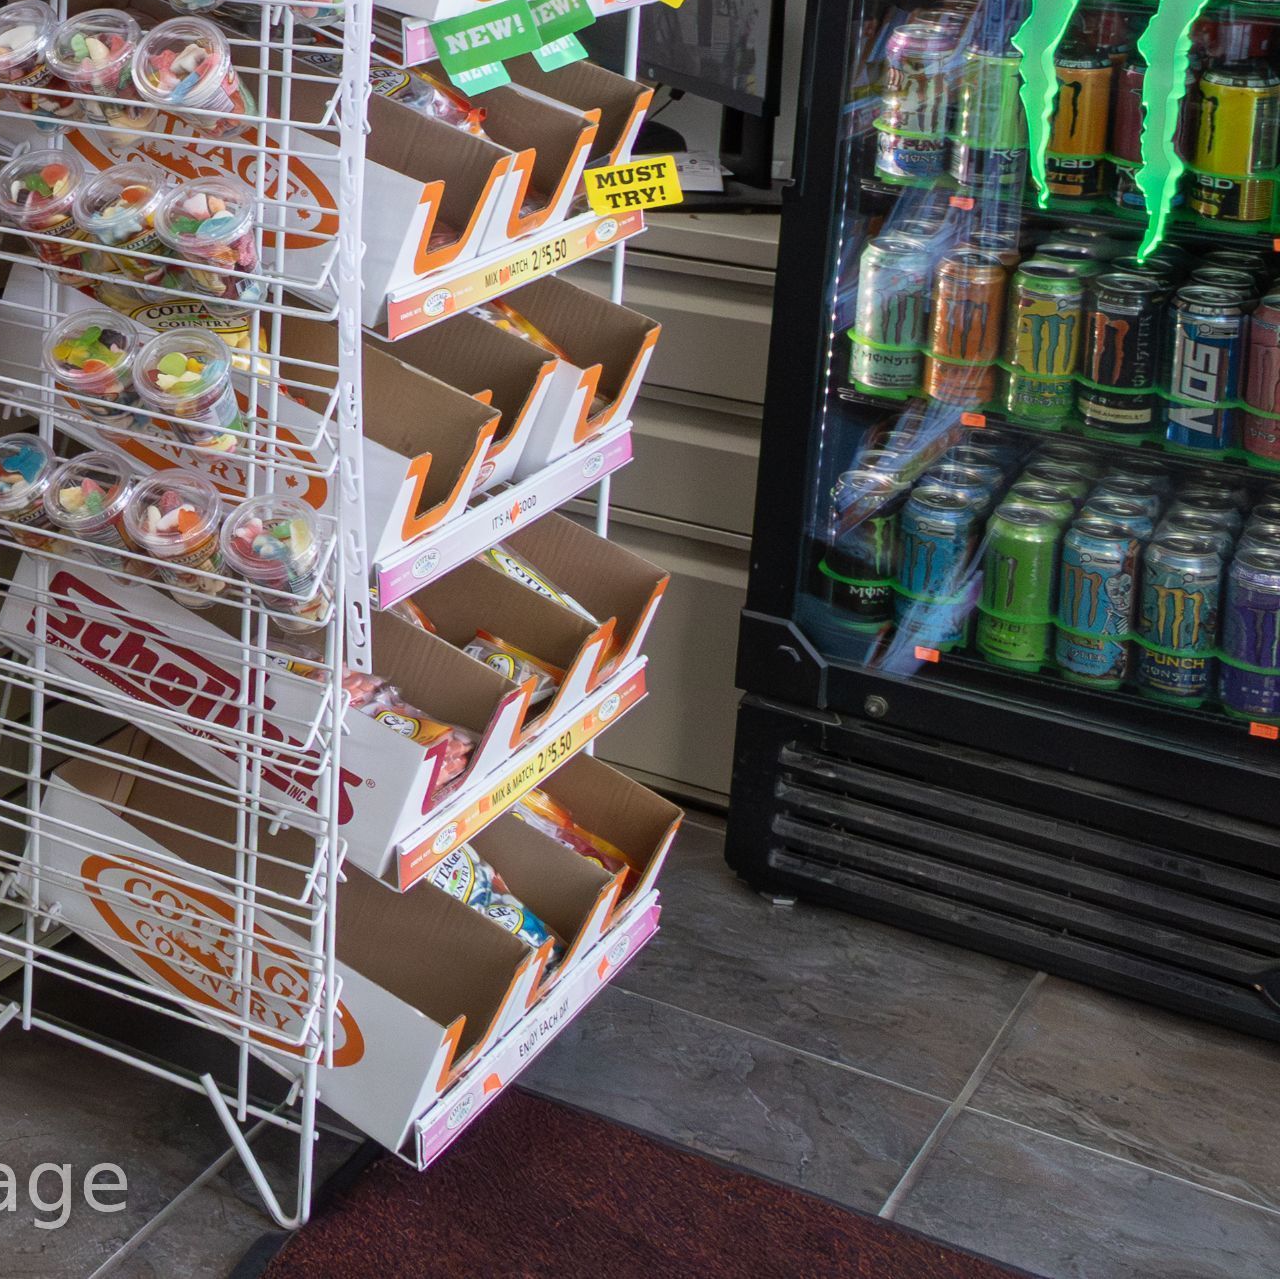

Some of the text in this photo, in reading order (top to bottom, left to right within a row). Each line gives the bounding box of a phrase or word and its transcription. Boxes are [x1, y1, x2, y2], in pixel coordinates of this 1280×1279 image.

[443, 13, 527, 56] NEW!
[595, 161, 666, 190] MUST
[605, 184, 666, 209] TRY!
